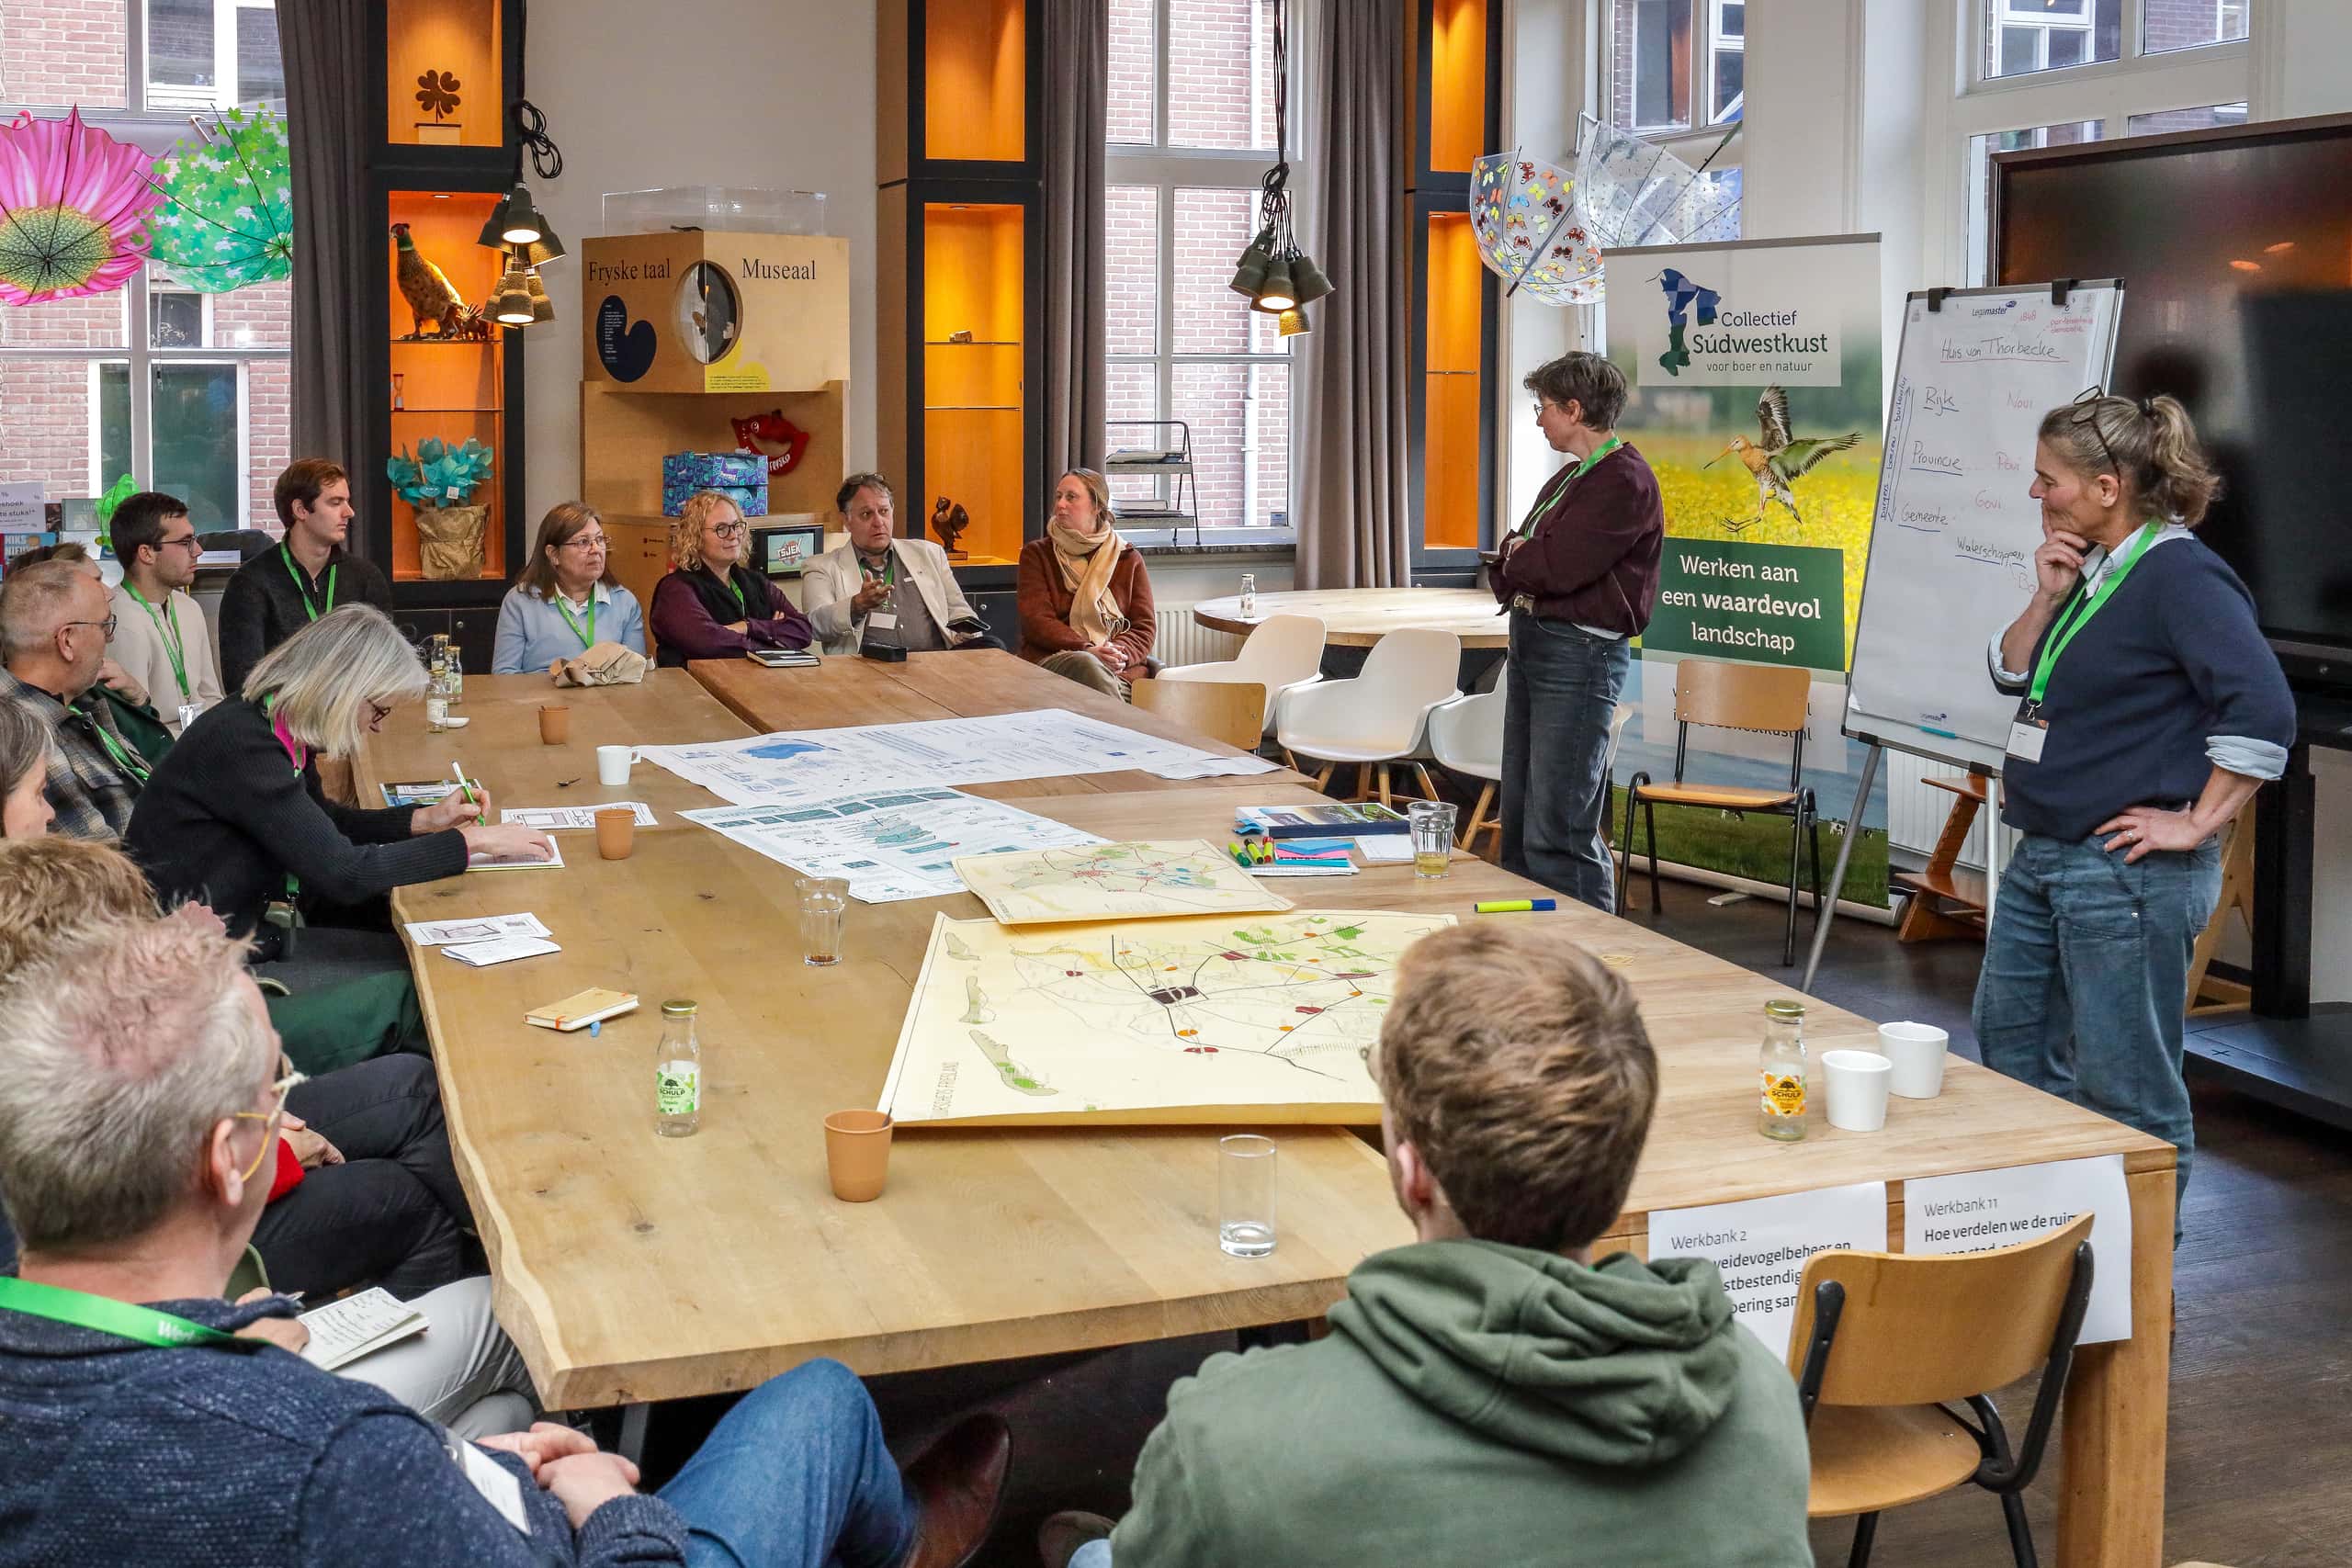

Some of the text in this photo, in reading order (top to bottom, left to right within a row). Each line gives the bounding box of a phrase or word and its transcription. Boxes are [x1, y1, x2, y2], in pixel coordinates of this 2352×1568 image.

[588, 258, 671, 286] Fryske taal
[742, 257, 817, 280] Museaal
[1721, 310, 1797, 327] Collectief
[1692, 332, 1828, 355] Súdwestkust
[1981, 336, 2061, 360] Thorbecke
[1706, 361, 1813, 372] voor boer en natuur
[1679, 554, 1799, 583] Werken aan
[1661, 590, 1821, 619] een waardevol
[1690, 621, 1795, 655] landschap
[1925, 1197, 1998, 1217] Werkbank 11
[1671, 1228, 1747, 1250] Werkbank 2
[1925, 1228, 1950, 1242] Hoe
[1952, 1220, 2007, 1238] verdelen
[2009, 1220, 2029, 1231] we
[2030, 1214, 2047, 1228] de
